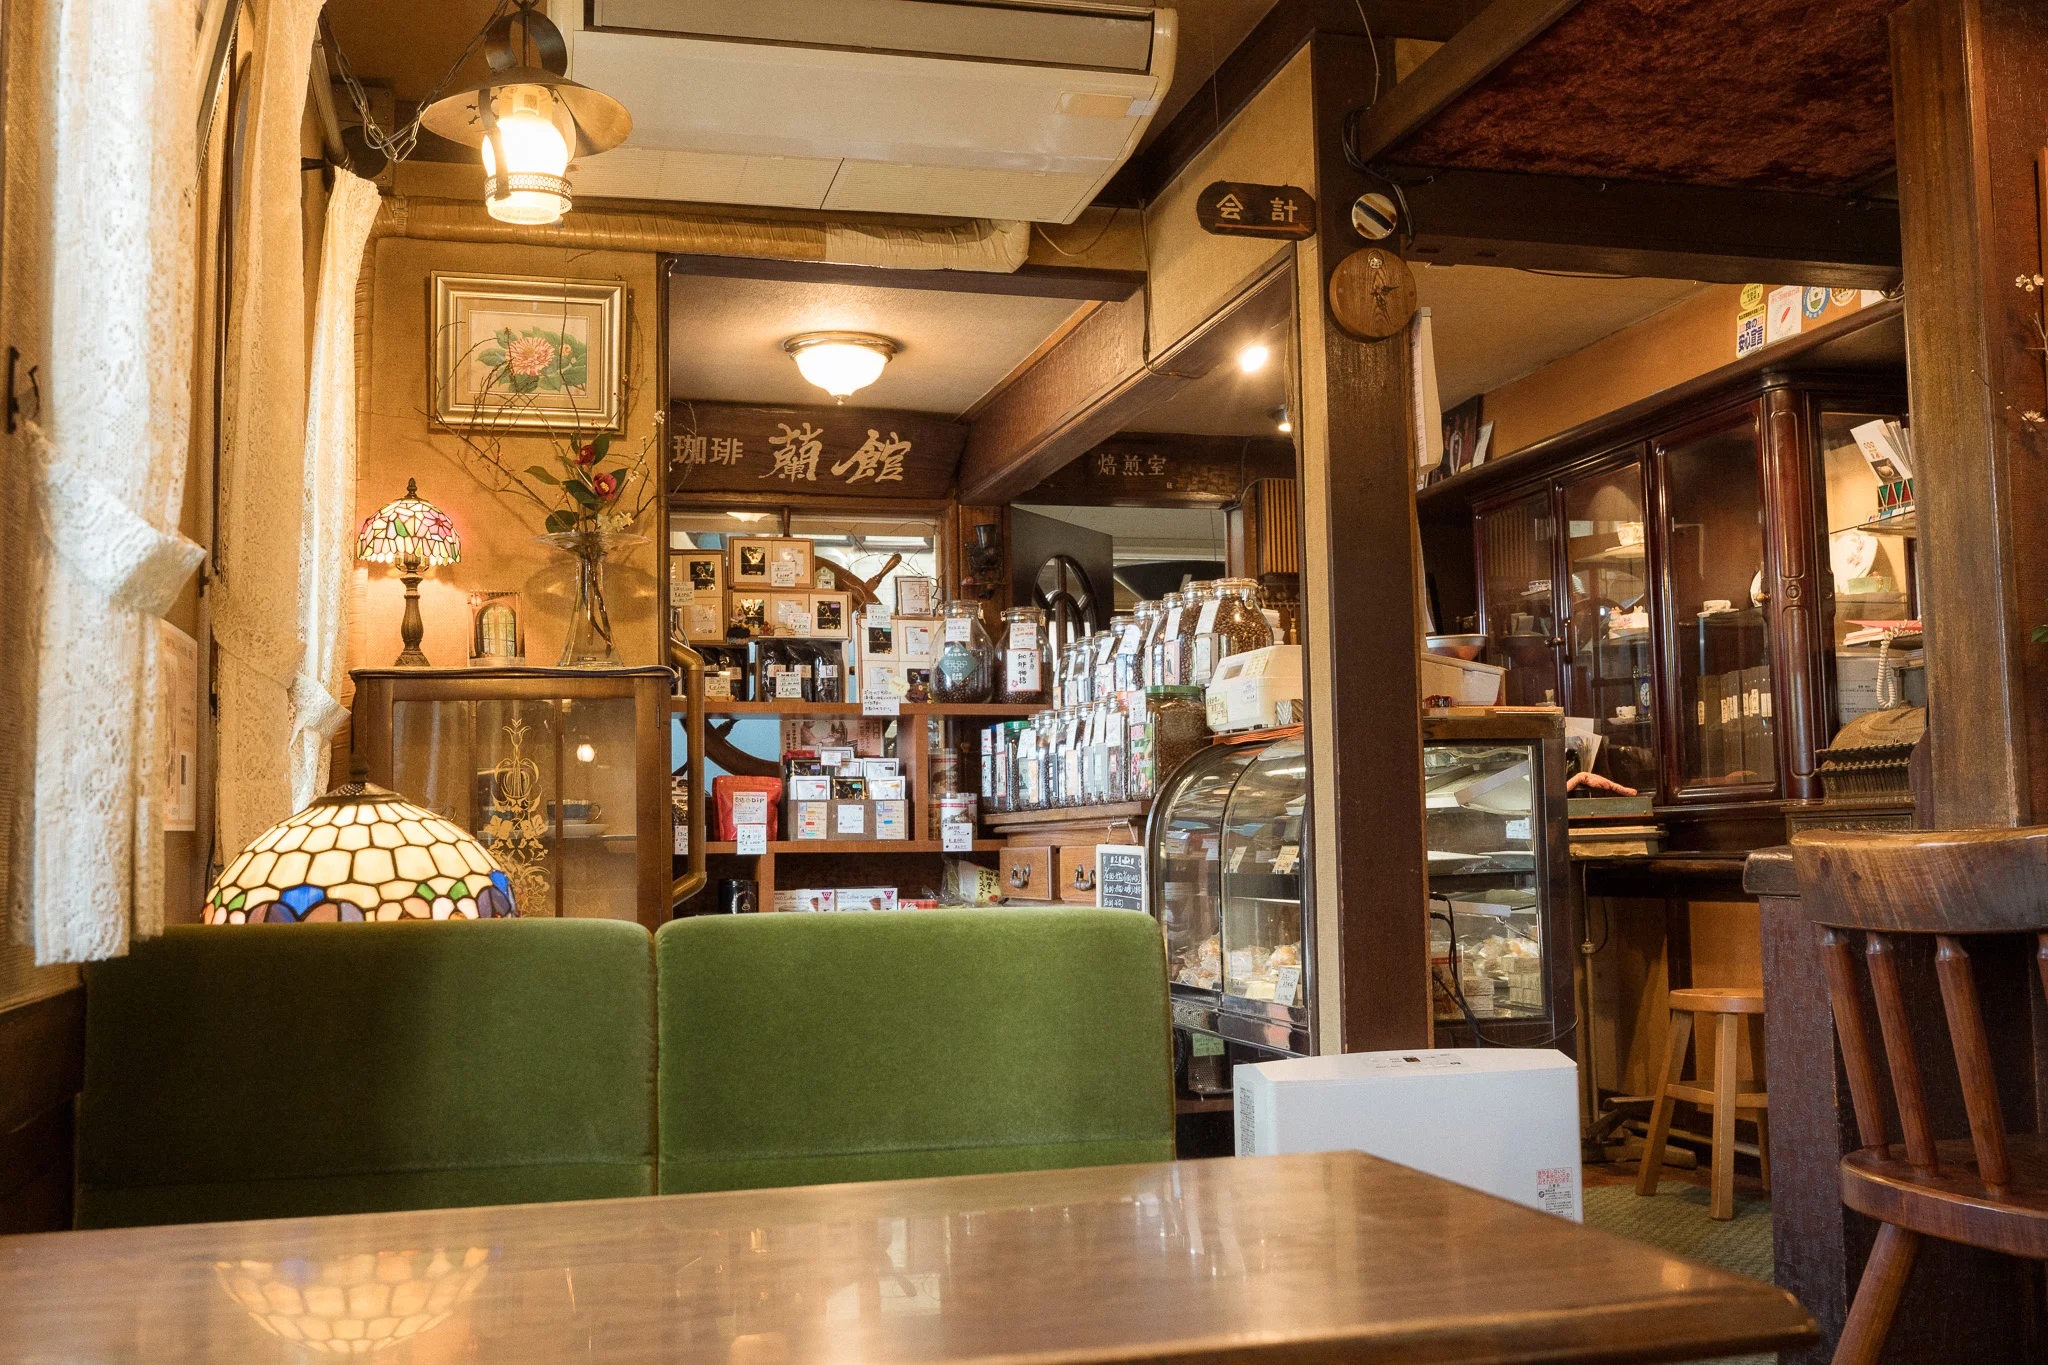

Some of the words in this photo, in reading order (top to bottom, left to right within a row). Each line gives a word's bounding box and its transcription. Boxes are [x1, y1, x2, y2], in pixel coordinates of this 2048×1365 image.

[1216, 193, 1298, 223] 会計
[1098, 453, 1167, 476] 焙煎室
